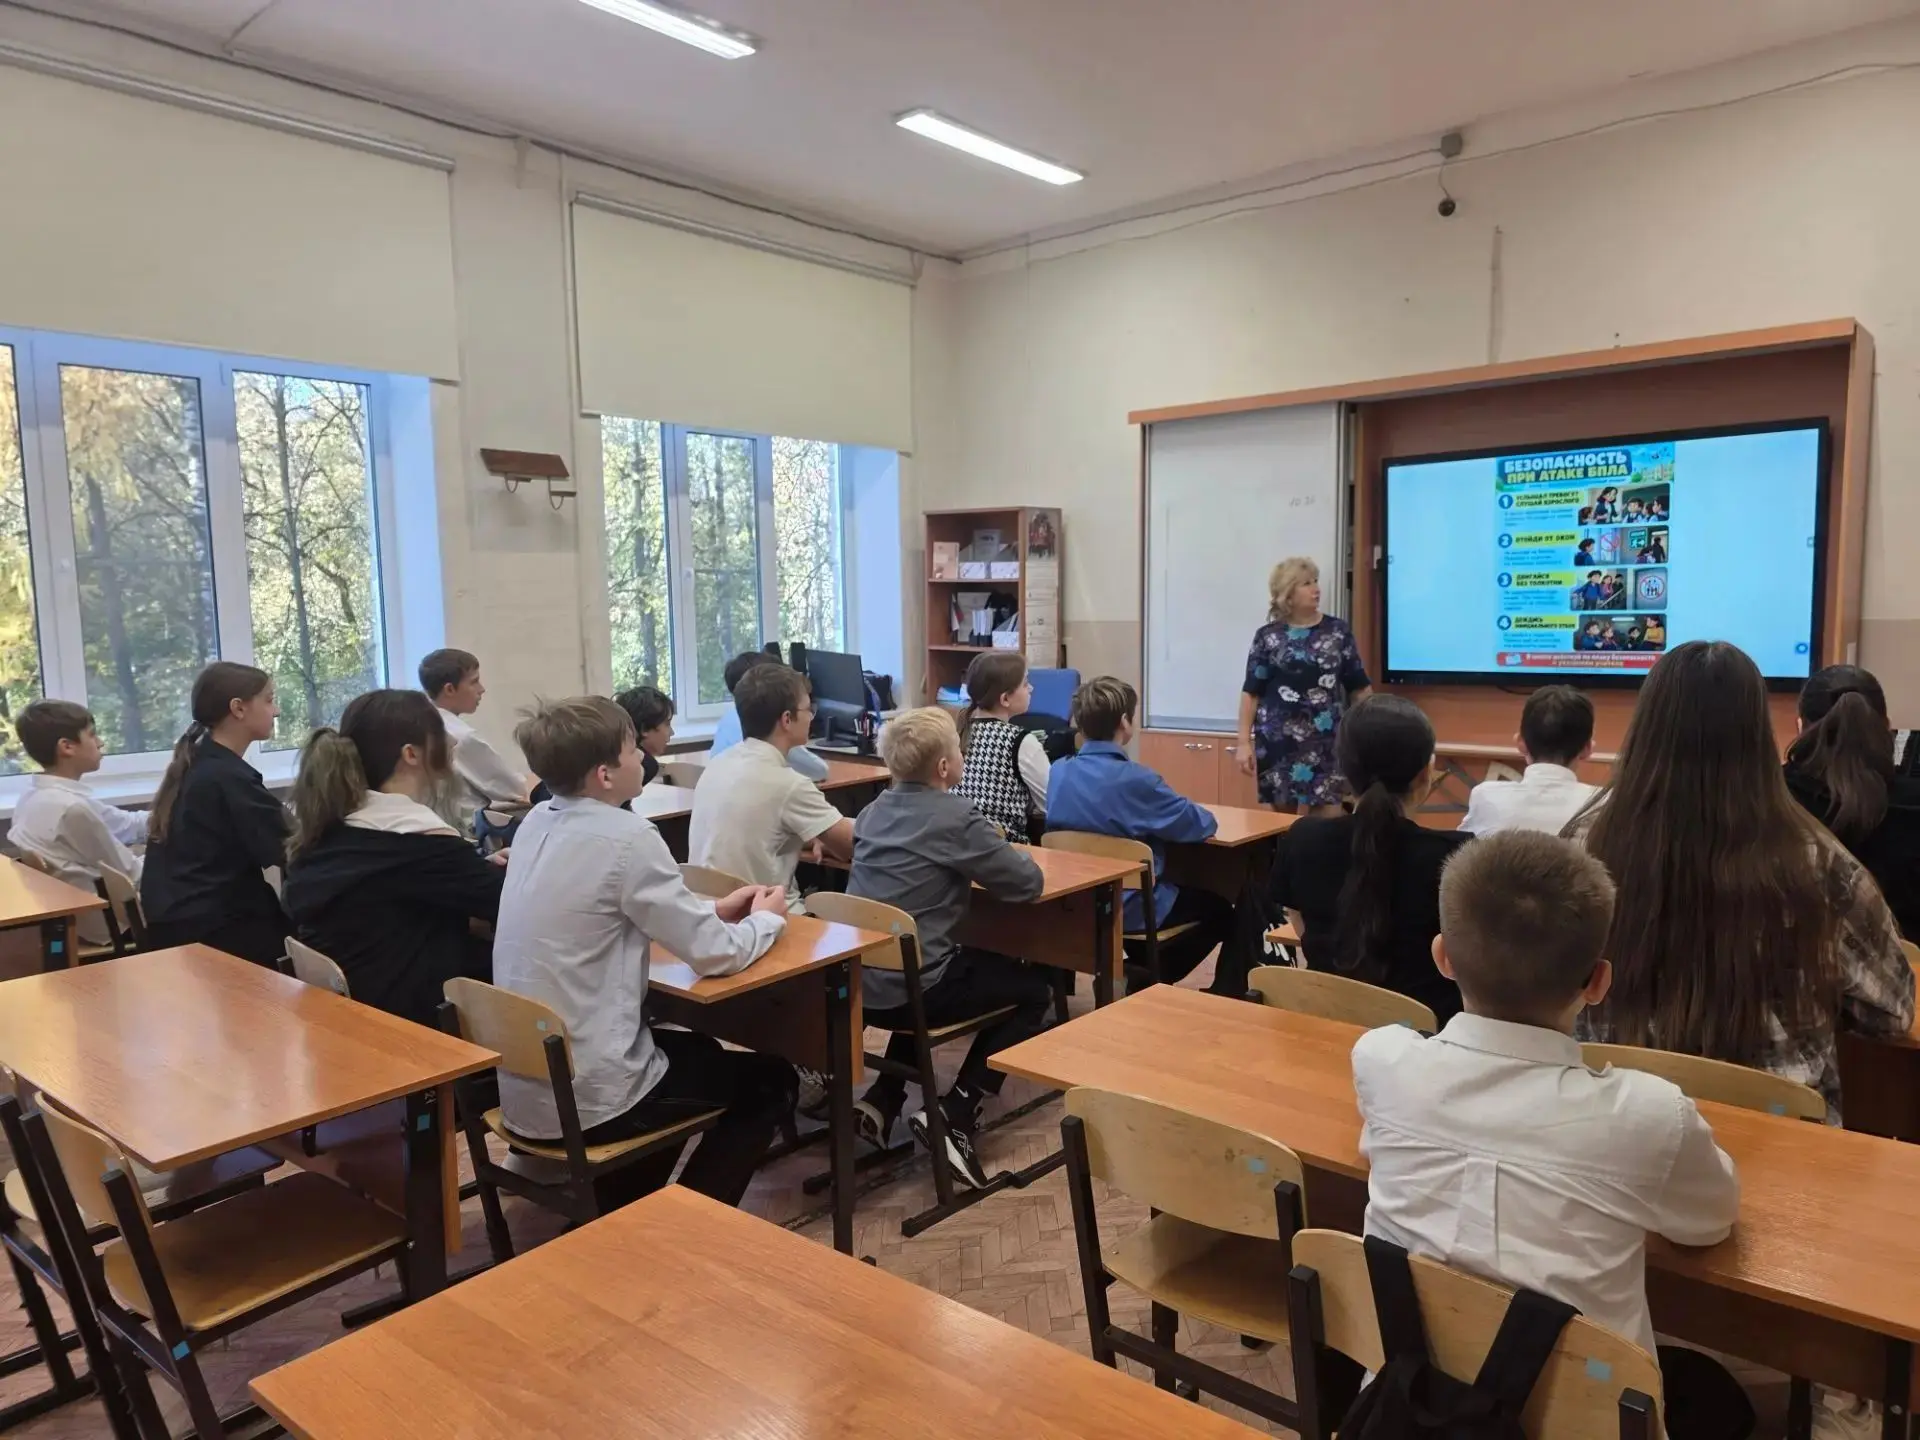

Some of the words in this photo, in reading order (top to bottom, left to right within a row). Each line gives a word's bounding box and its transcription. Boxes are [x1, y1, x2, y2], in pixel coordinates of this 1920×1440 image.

[1504, 451, 1627, 473] БЕЗОПАСНОСТЬ
[1507, 471, 1536, 484] ПРИ
[1538, 467, 1584, 482] АТАКЕ
[1587, 464, 1628, 478] БПЛА
